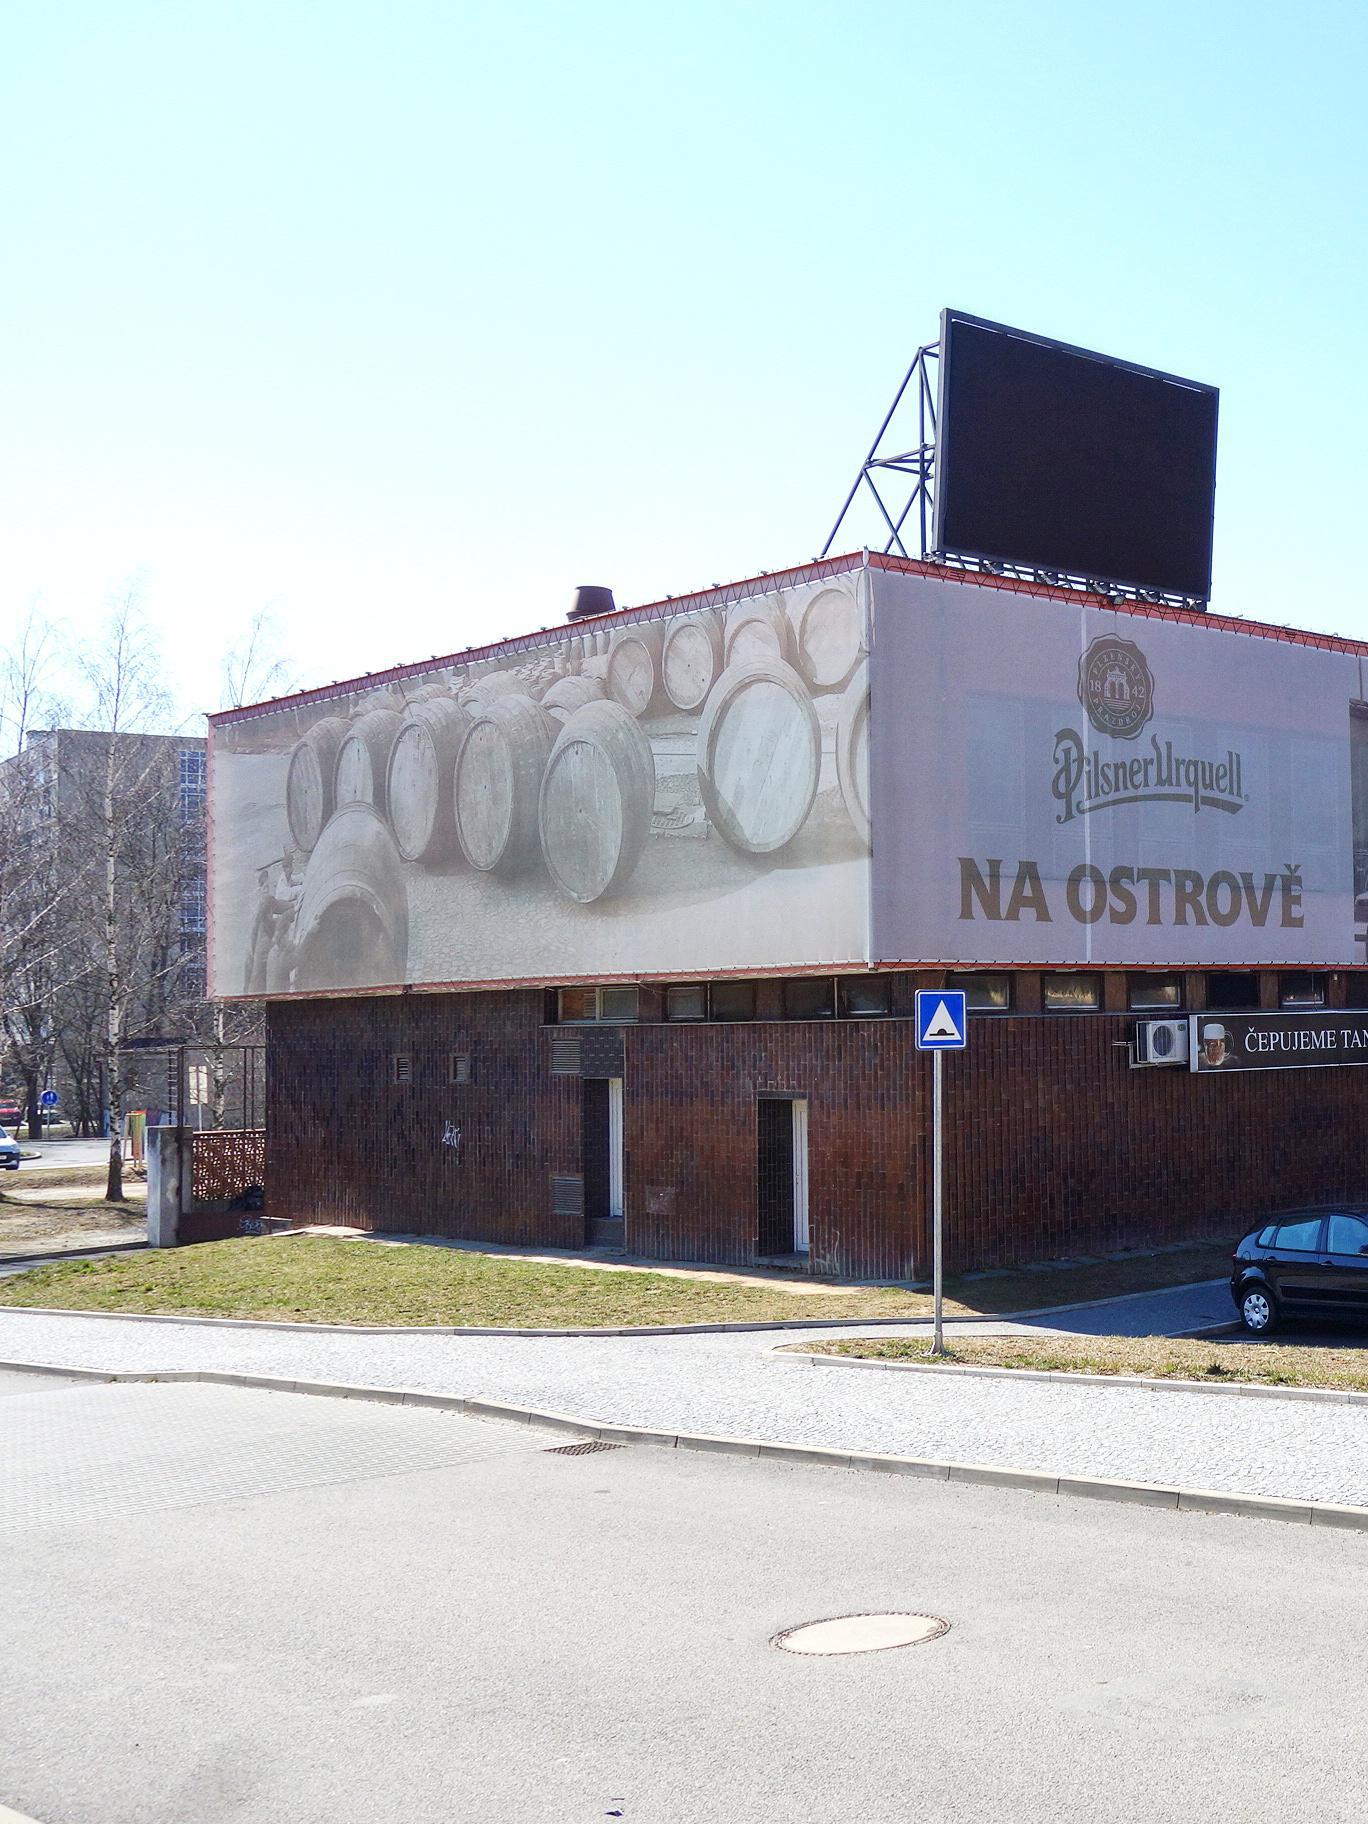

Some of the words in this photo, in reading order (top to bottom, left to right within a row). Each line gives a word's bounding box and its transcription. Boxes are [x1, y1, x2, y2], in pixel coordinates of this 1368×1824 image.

[1090, 680, 1102, 692] 18
[1132, 686, 1145, 697] 42
[1051, 728, 1155, 825] Pilsner
[1150, 733, 1242, 815] Urquell
[958, 857, 1053, 922] NA
[1066, 863, 1304, 928] OSTROVĚ
[1244, 1026, 1337, 1053] ČEPUJEME
